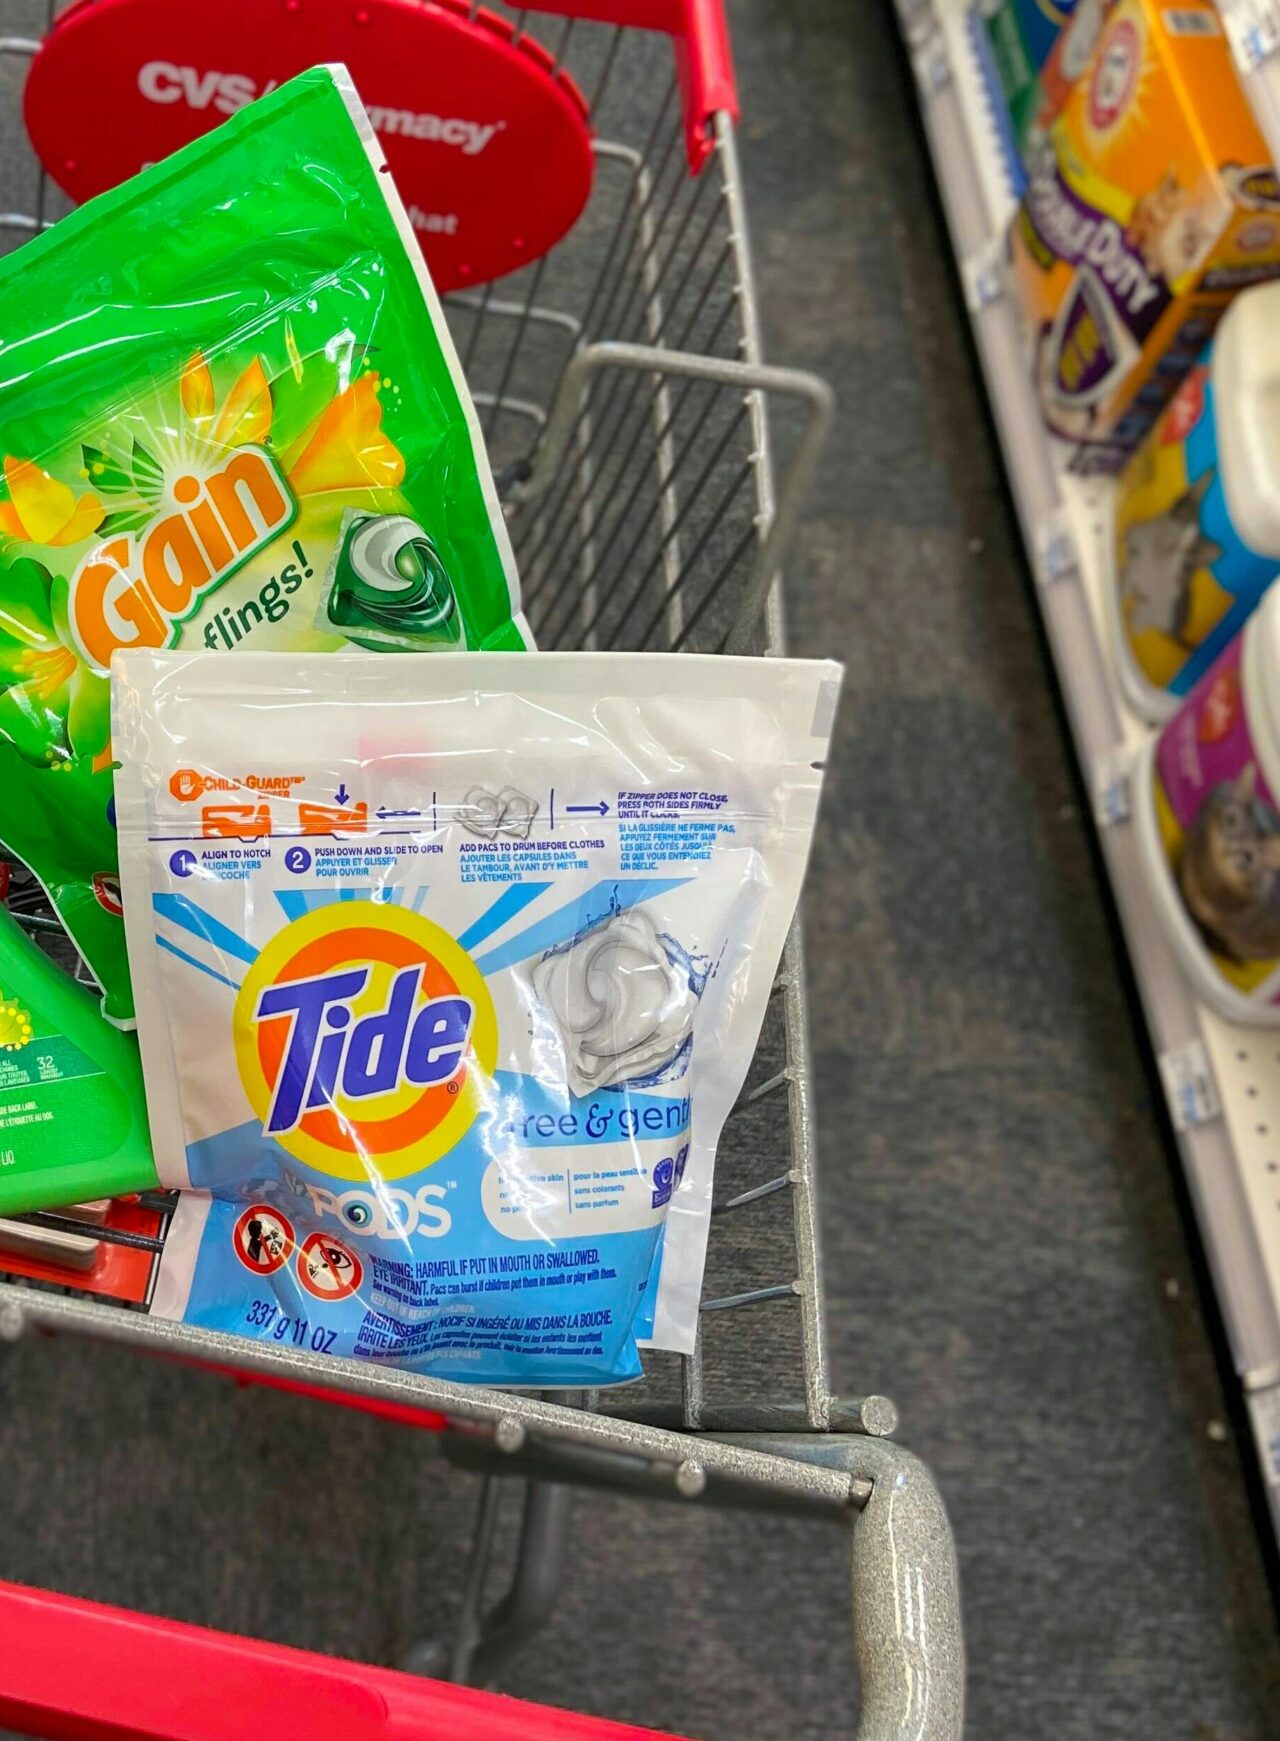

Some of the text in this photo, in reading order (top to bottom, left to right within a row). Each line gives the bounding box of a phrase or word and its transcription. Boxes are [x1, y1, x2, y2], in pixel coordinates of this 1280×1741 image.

[69, 442, 293, 669] Gain
[201, 539, 316, 653] flings!
[617, 791, 697, 801] IF ZIPPER DOES NOT
[617, 799, 721, 811] PRESS SIDES FIRMLY
[617, 809, 648, 819] UNTIL IT
[618, 822, 716, 832] SI LA FERME
[619, 830, 716, 842] APPUYEZ FERMEMENT SUR
[314, 844, 443, 856] PUSH DOWN AND TO OPEN
[459, 839, 604, 852] ADD PACS TO DRUM BEFORE CLOTHES
[620, 842, 652, 851] LES DEUX
[201, 848, 271, 859] ALIGN TO NOTCH
[292, 851, 303, 868] 2
[459, 851, 576, 863] AJOUTER LES CAPSULES DANS
[631, 852, 644, 860] QUE
[646, 851, 666, 860] VOUS
[240, 860, 261, 869] VERS
[315, 857, 362, 867] APPUYER ET
[460, 860, 588, 872] LE AVANT METTRE
[315, 867, 368, 877] POUR OUVRIR
[461, 871, 522, 882] LES VÊTEMENTS
[256, 962, 472, 1138] Tide
[36, 1055, 54, 1069] 32
[585, 1102, 615, 1138] &
[618, 1093, 692, 1140] gentl
[547, 1173, 563, 1181] skin
[573, 1170, 618, 1181] pour la peau
[574, 1184, 624, 1194] sans colorants
[592, 1199, 618, 1208] parfum
[414, 1248, 600, 1279] HARMFUL IF PUT IN MOUTH OR SWALLOWED.
[373, 1264, 446, 1298] EYE IRRITANT. Pacs
[437, 1309, 612, 1330] NOCIF OU MIS DANS LA BOUCHE.
[244, 1299, 277, 1325] 331
[277, 1316, 291, 1340] g
[292, 1319, 307, 1346] 11
[310, 1326, 337, 1357] OZ
